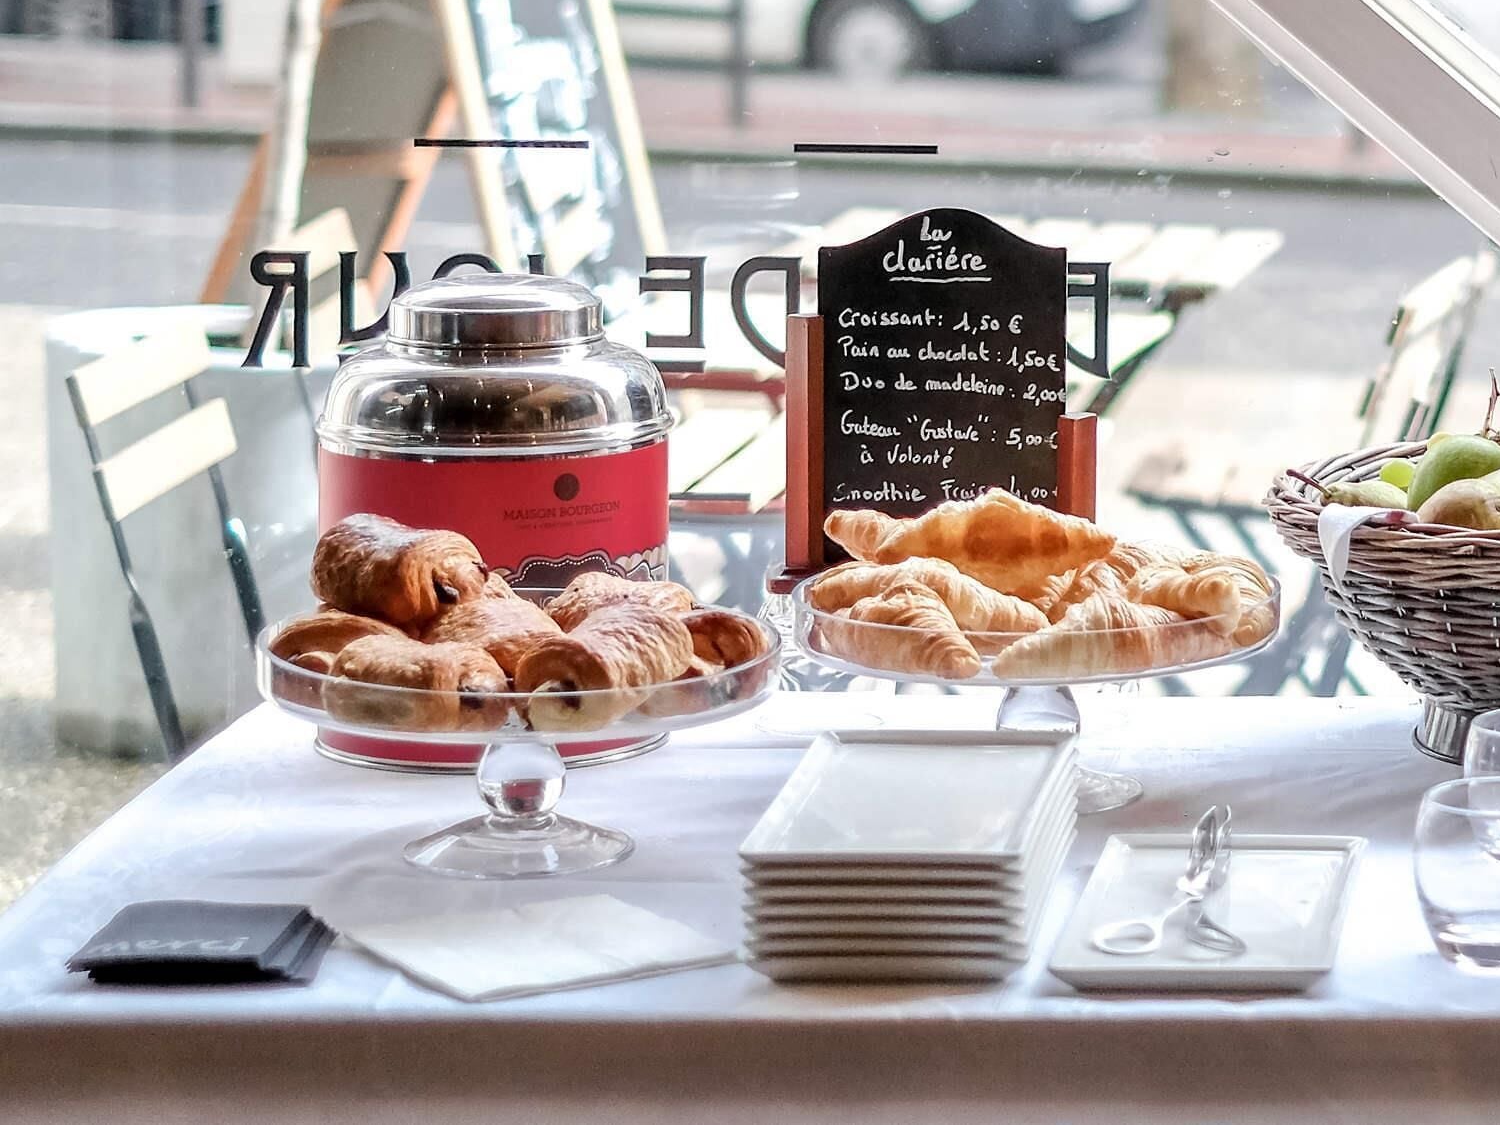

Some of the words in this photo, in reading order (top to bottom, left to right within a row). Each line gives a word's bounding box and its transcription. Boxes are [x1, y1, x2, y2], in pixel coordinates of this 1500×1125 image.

[919, 215, 952, 242] La
[838, 335, 879, 358] Pain
[886, 345, 912, 358] au
[918, 341, 992, 363] chocolat
[840, 371, 885, 391] Duo
[894, 371, 918, 391] de
[503, 507, 557, 522] MAISON
[559, 500, 622, 517] BOURGEON
